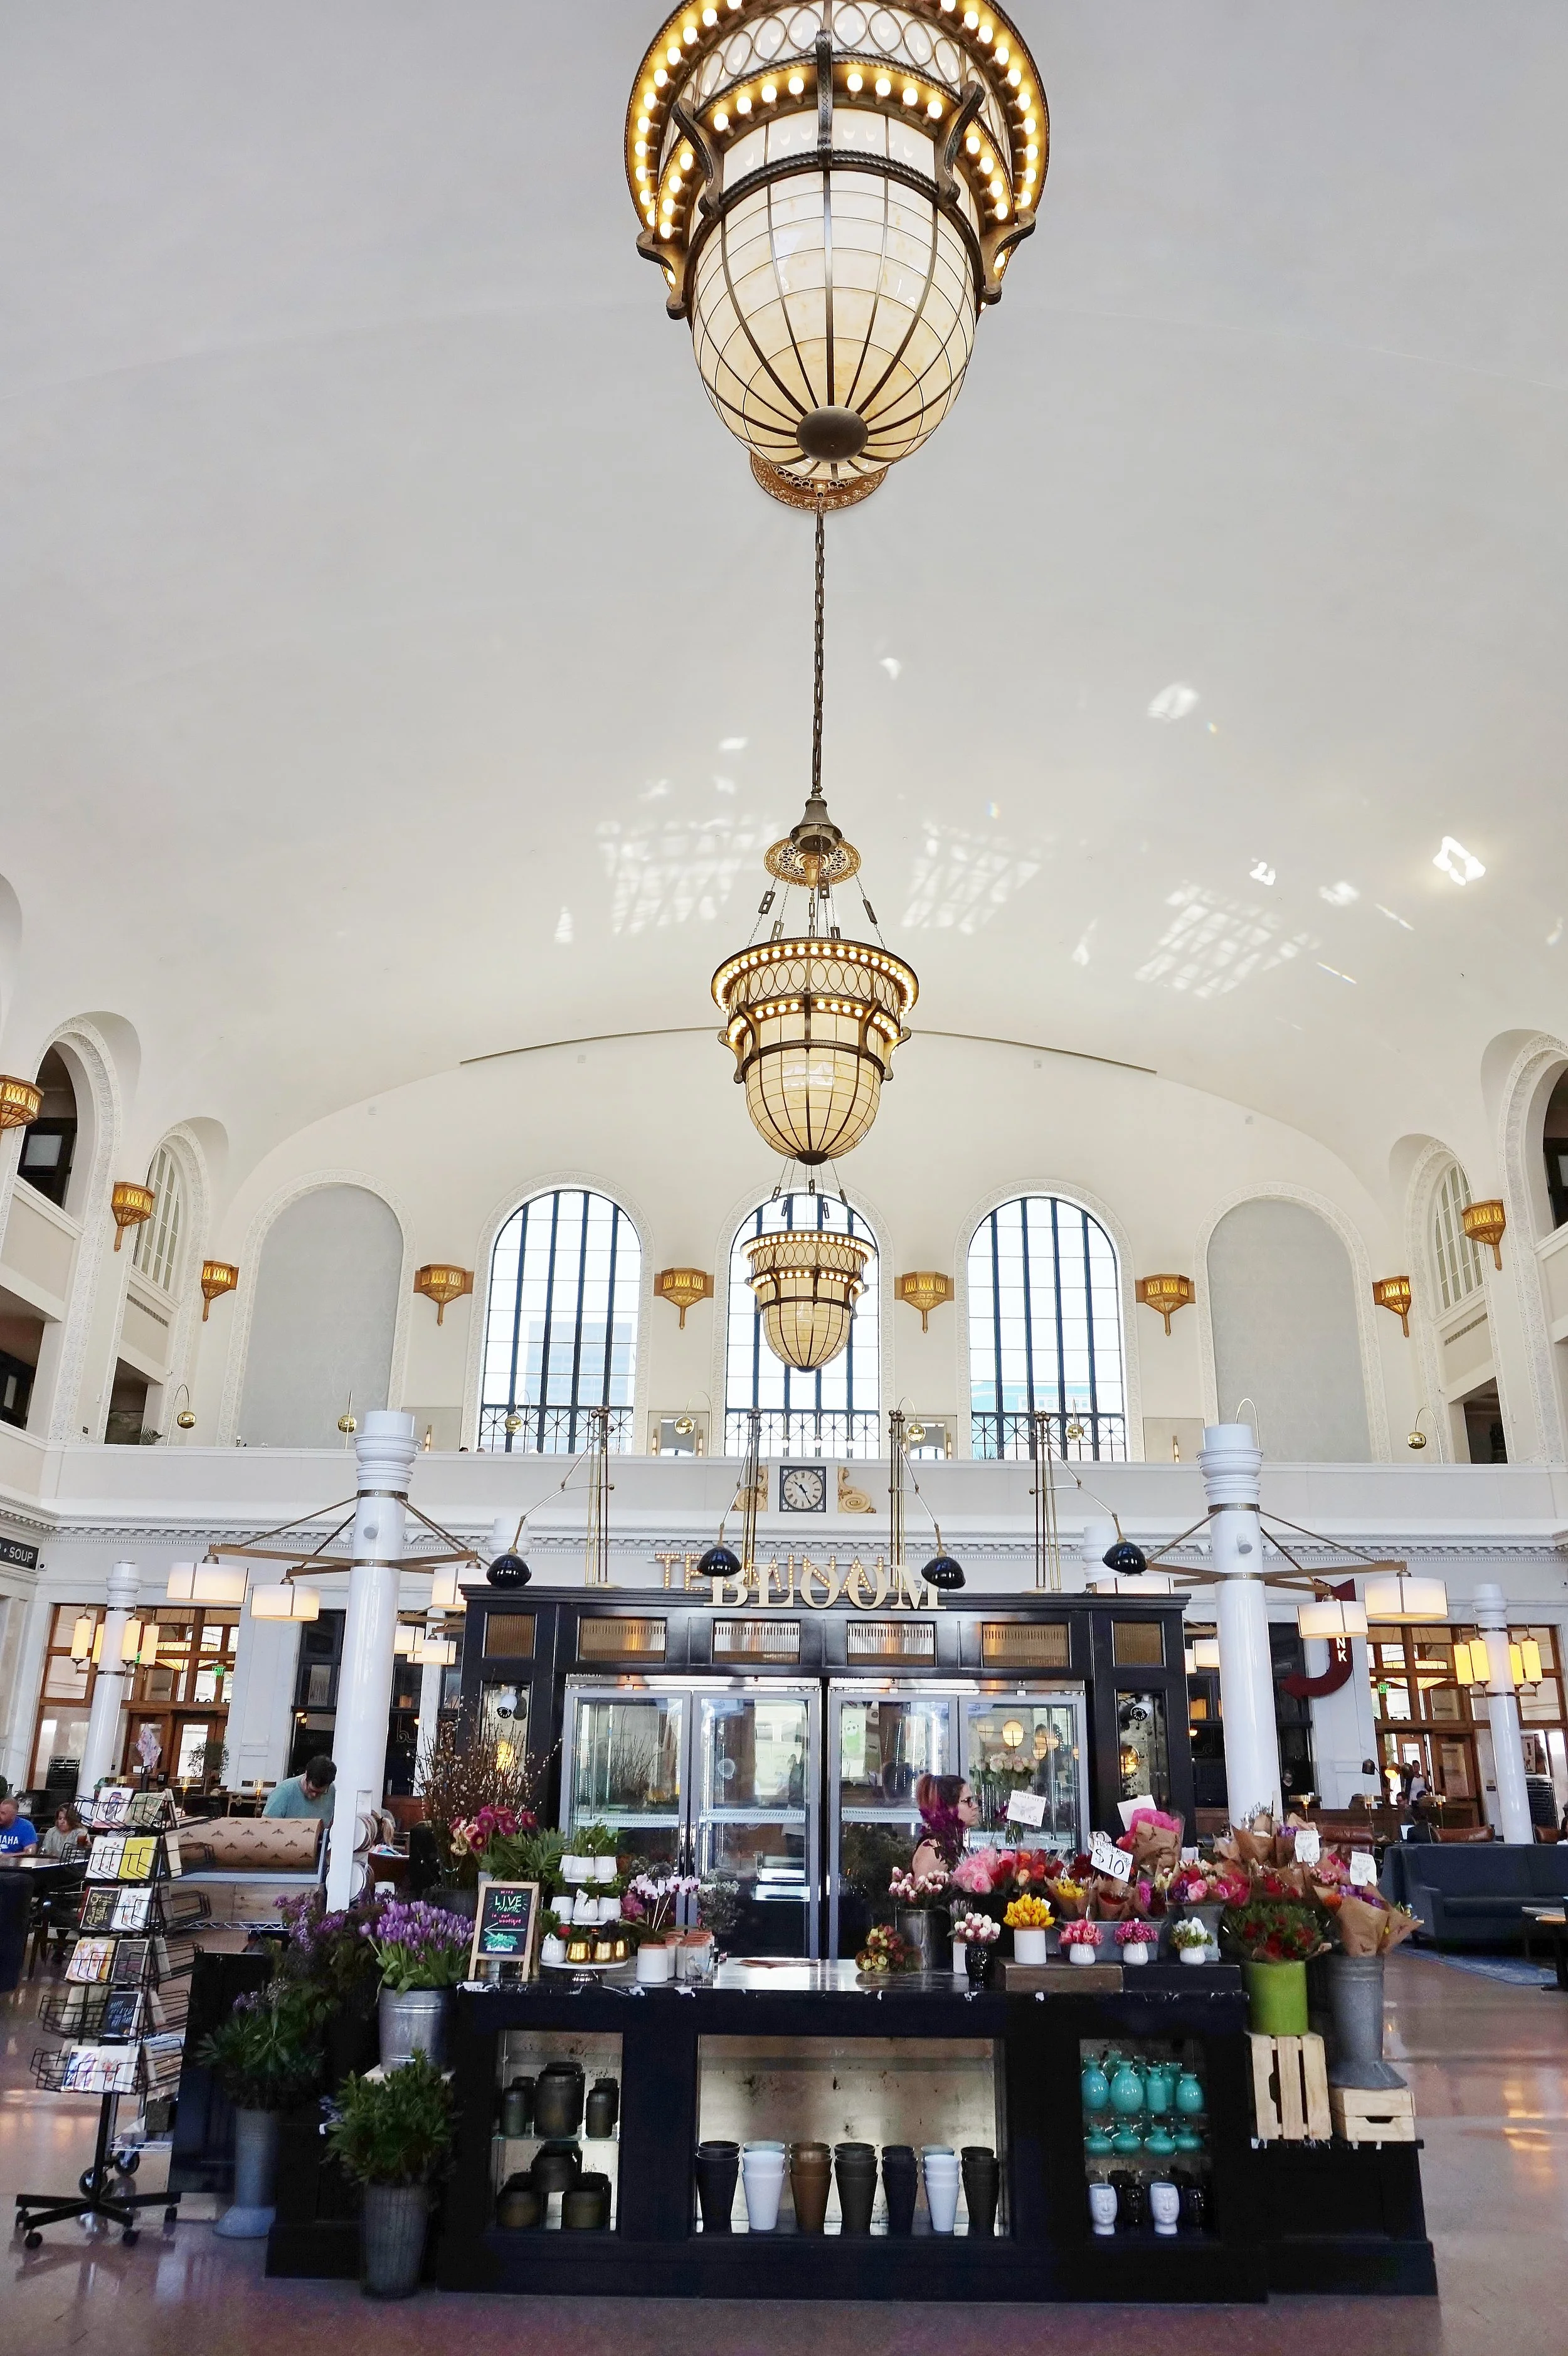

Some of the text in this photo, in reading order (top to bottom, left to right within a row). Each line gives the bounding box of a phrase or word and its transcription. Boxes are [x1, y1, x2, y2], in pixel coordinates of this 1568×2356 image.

[9, 1546, 33, 1563] SOUP
[703, 1564, 946, 1610] BLOOM
[1095, 1848, 1125, 1875] $10
[495, 1895, 522, 1906] LIVE
